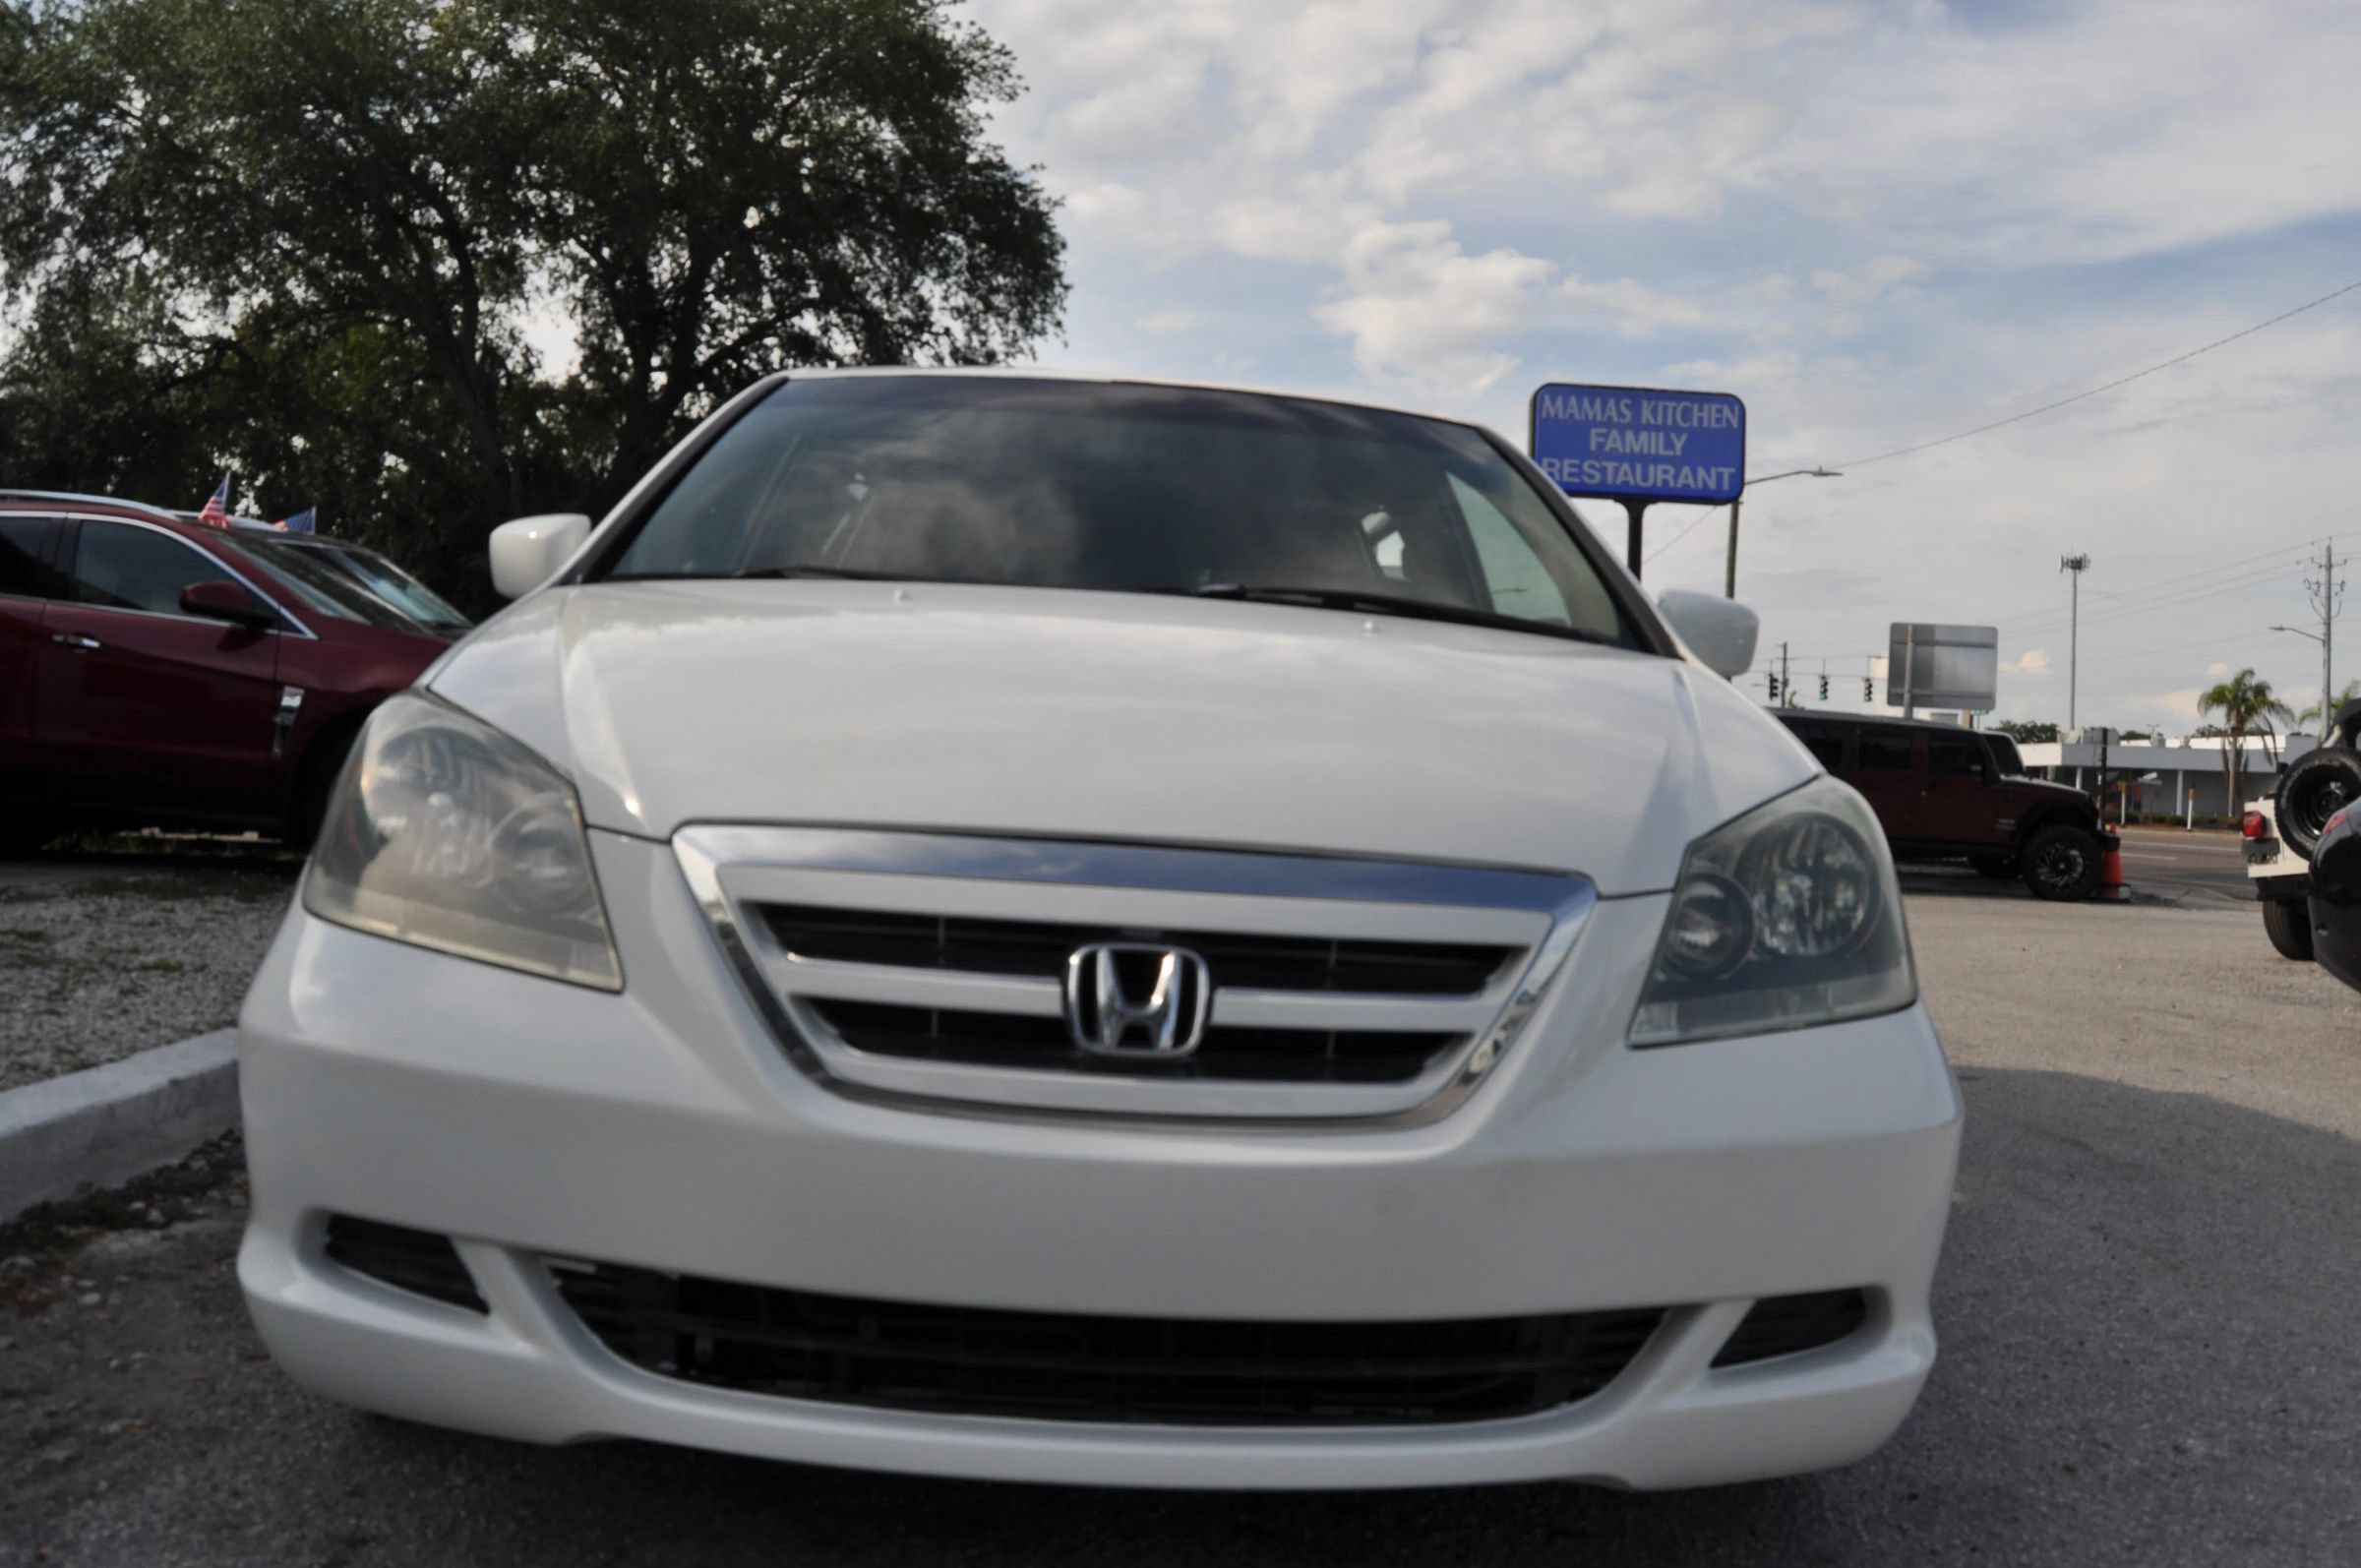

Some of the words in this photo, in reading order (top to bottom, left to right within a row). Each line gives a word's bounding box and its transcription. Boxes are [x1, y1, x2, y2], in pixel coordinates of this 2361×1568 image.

[1542, 395, 1631, 423] MAMAS
[1642, 400, 1739, 428] KITCHEN
[1590, 429, 1688, 455] FAMILY
[1542, 457, 1735, 491] RESTAURANT
